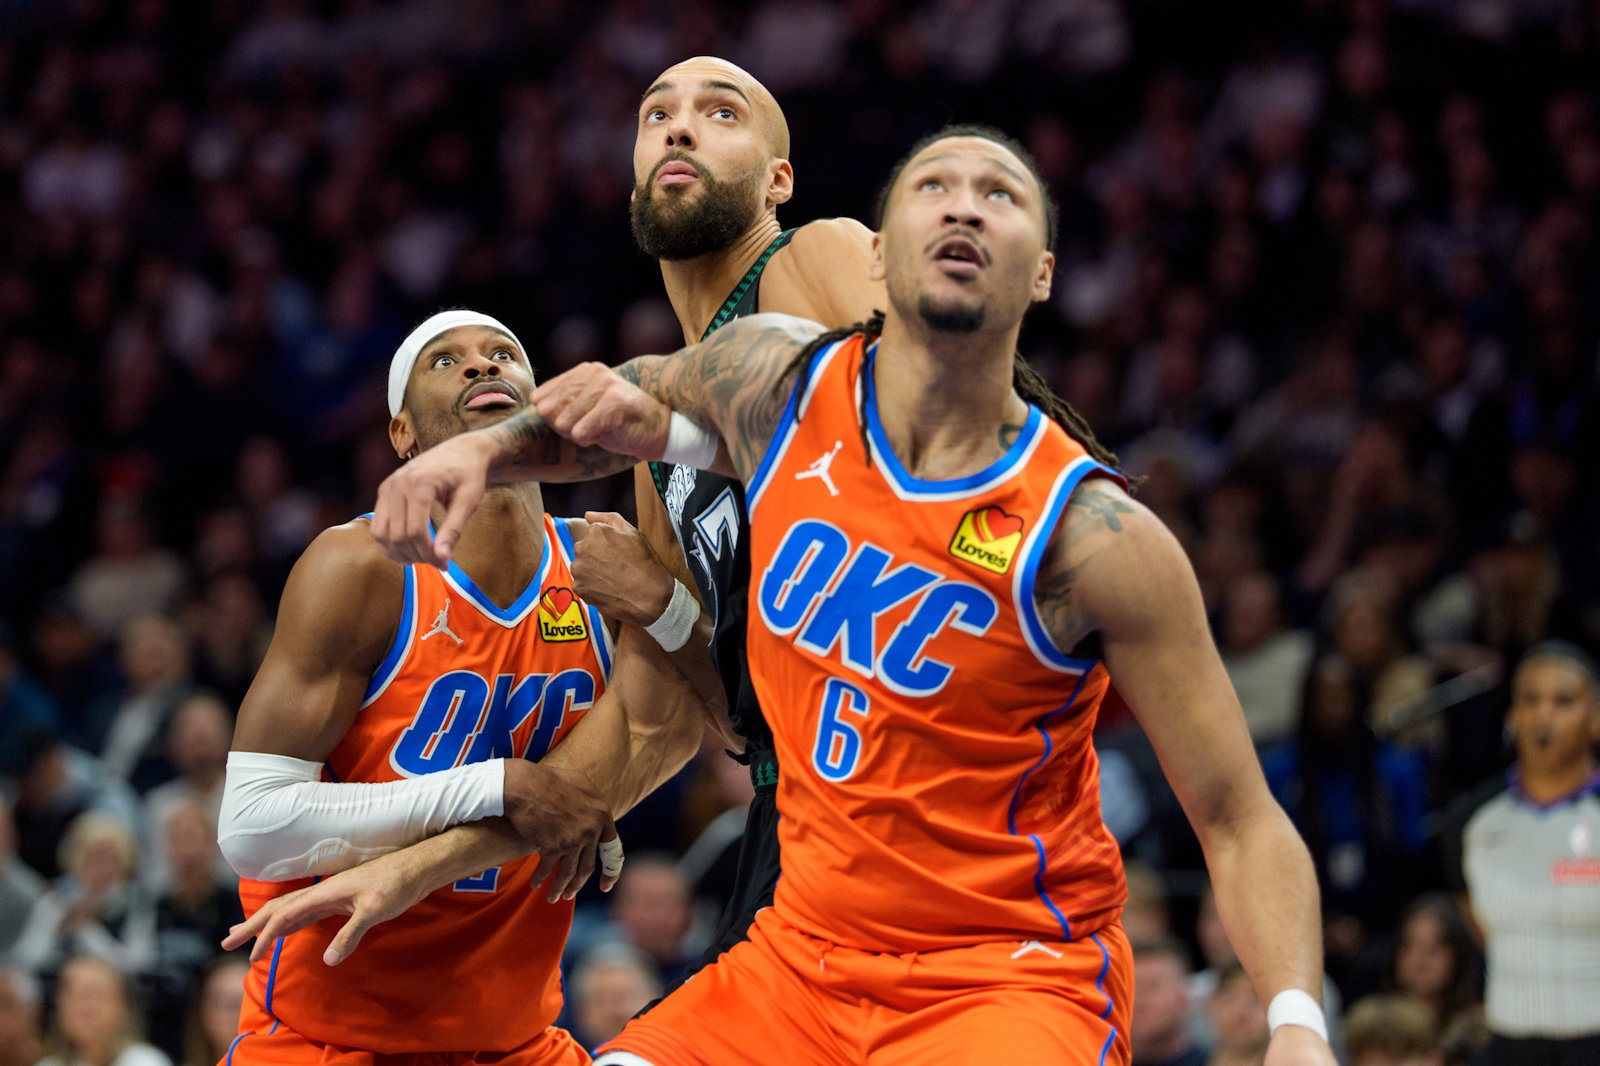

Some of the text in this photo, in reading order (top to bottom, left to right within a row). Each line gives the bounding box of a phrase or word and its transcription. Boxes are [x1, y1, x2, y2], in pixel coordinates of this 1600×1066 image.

[758, 518, 999, 697] OKC
[389, 669, 597, 780] OKC
[812, 676, 871, 783] 6
